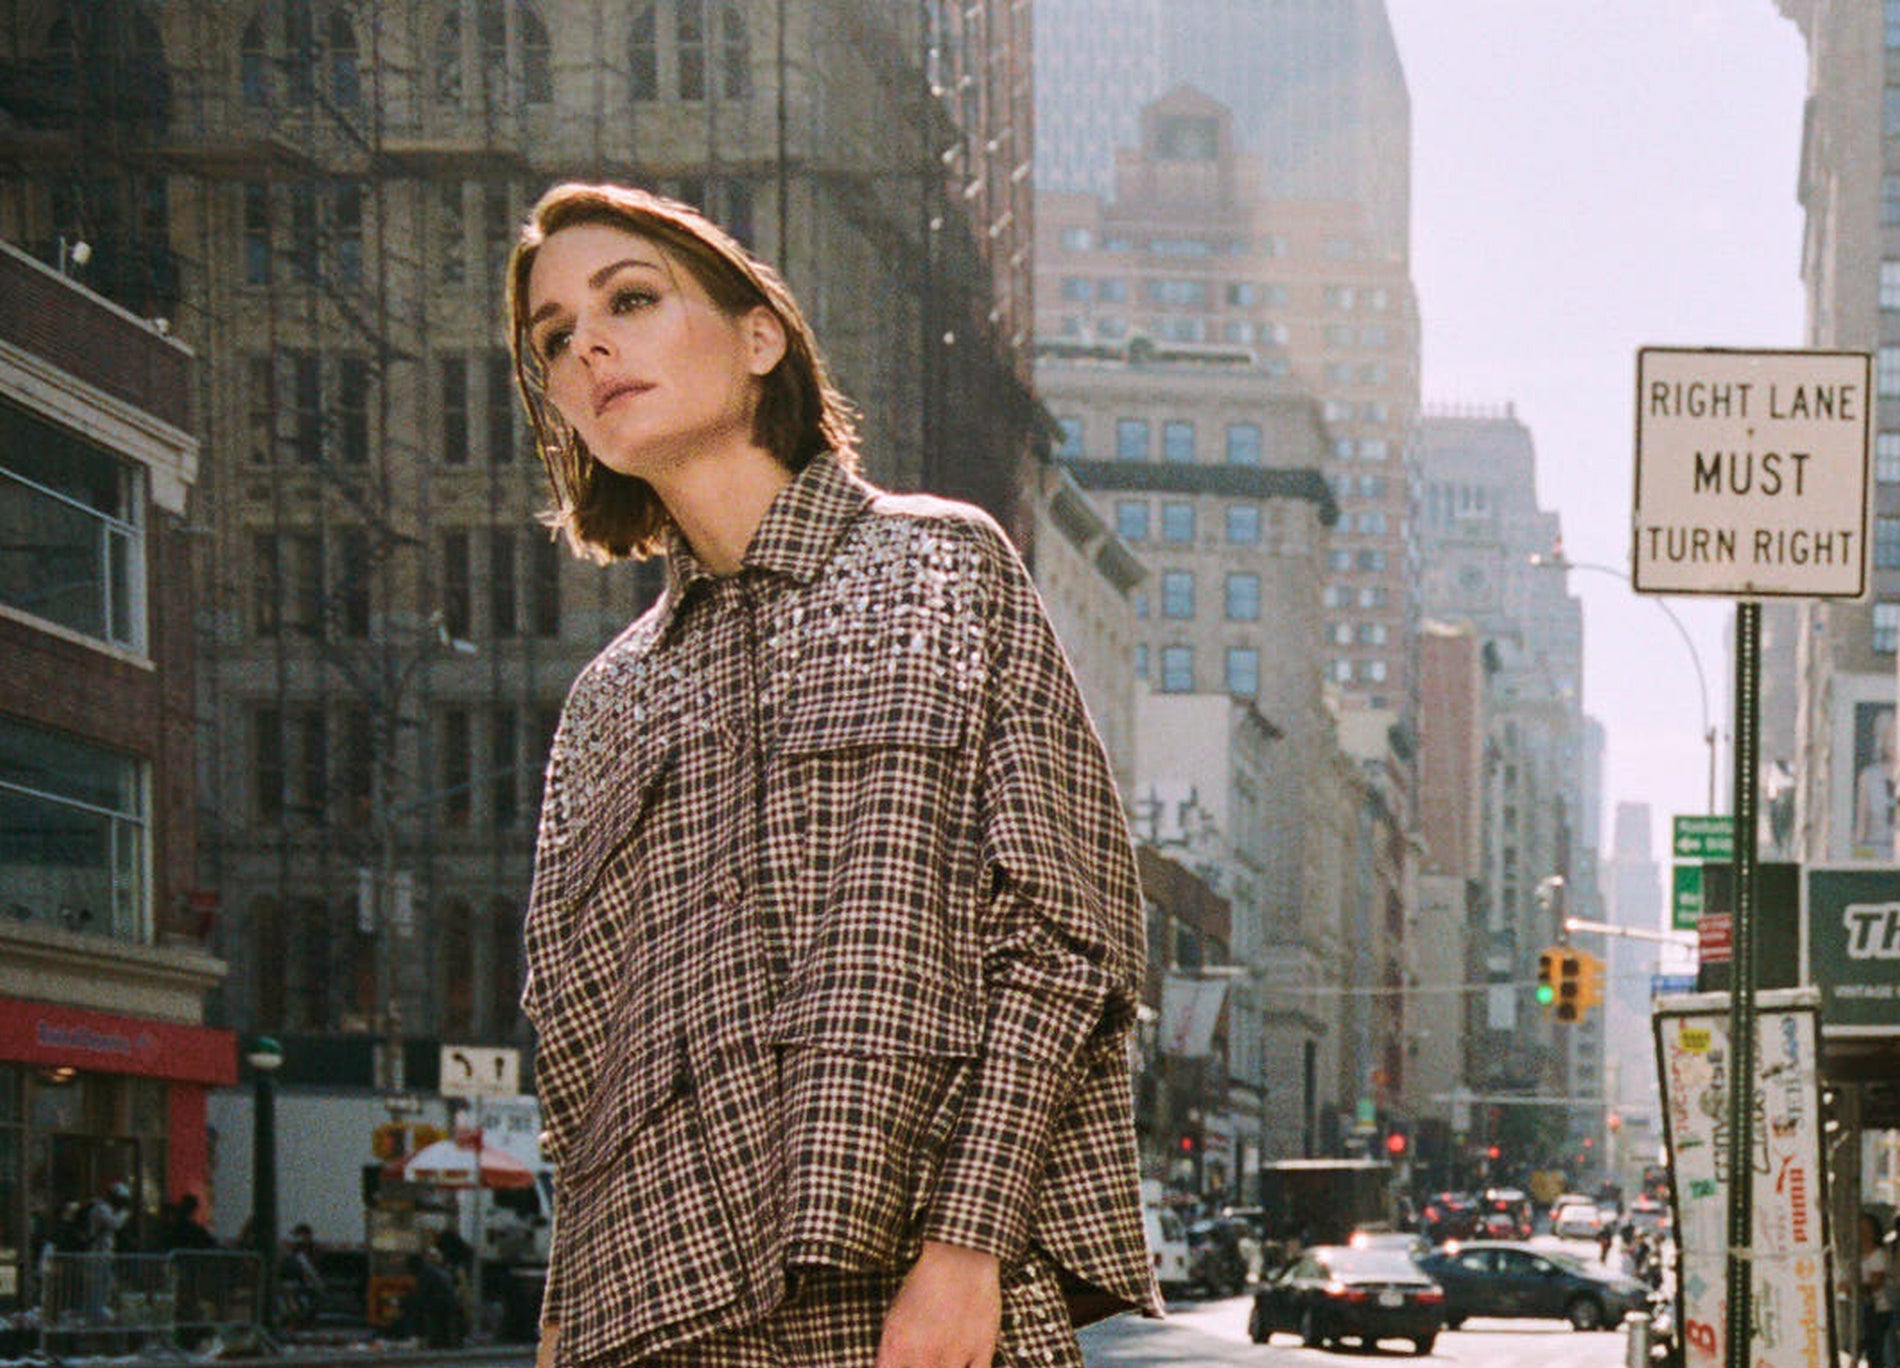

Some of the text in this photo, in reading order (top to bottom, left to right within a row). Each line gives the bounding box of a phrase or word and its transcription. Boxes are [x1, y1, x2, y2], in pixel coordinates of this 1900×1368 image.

[1651, 381, 1856, 420] RIGHT LANE
[1693, 451, 1810, 496] MUST
[1648, 527, 1854, 565] TURN RIGHT
